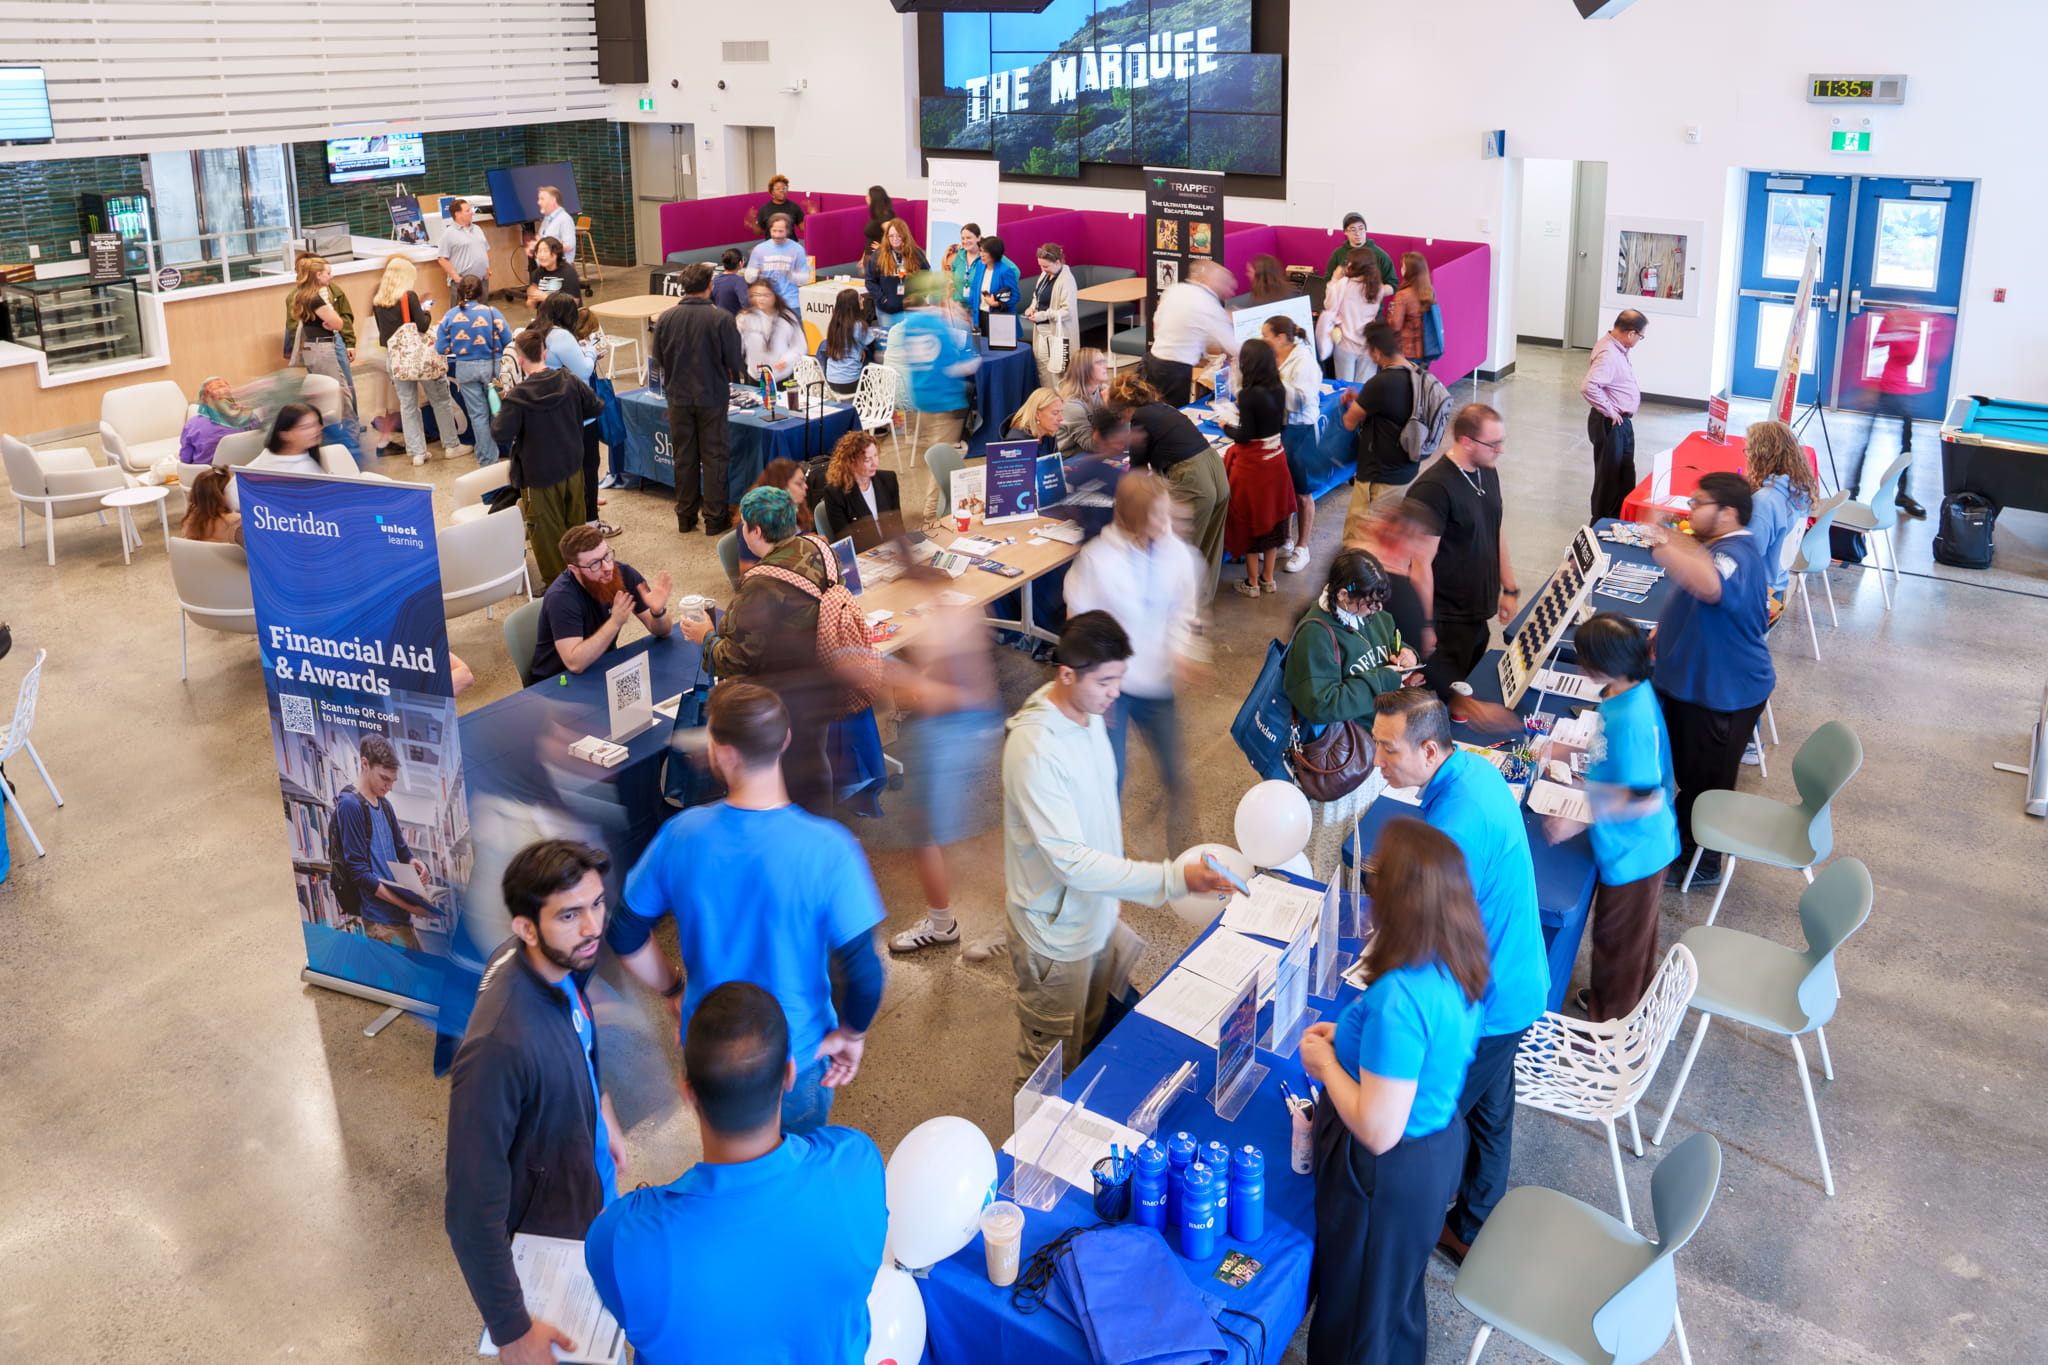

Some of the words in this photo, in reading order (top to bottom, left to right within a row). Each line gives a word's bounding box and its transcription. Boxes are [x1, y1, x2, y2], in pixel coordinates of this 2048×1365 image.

[966, 66, 1029, 128] THE
[1050, 26, 1218, 104] MARQUEE
[1814, 80, 1862, 97] 11:35
[932, 179, 968, 188] Confidence
[1169, 182, 1216, 194] TRAPPED
[1163, 201, 1187, 209] ULTIMATE
[1164, 207, 1184, 215] ESCAPE
[662, 275, 686, 297] fre
[806, 302, 834, 314] ALUM
[654, 431, 674, 458] Sh
[253, 505, 341, 538] Sheridan
[380, 524, 418, 536] unlock
[388, 535, 424, 549] learning
[268, 625, 386, 666] Financial
[390, 644, 437, 674] Aid
[275, 656, 294, 680] &
[299, 659, 391, 697] Awards
[320, 700, 343, 714] Scan
[344, 704, 361, 716] the
[362, 707, 376, 720] QR
[377, 710, 400, 724] code
[322, 713, 331, 723] to
[333, 712, 358, 727] learn
[359, 720, 383, 732] more
[1142, 1199, 1159, 1207] BMO
